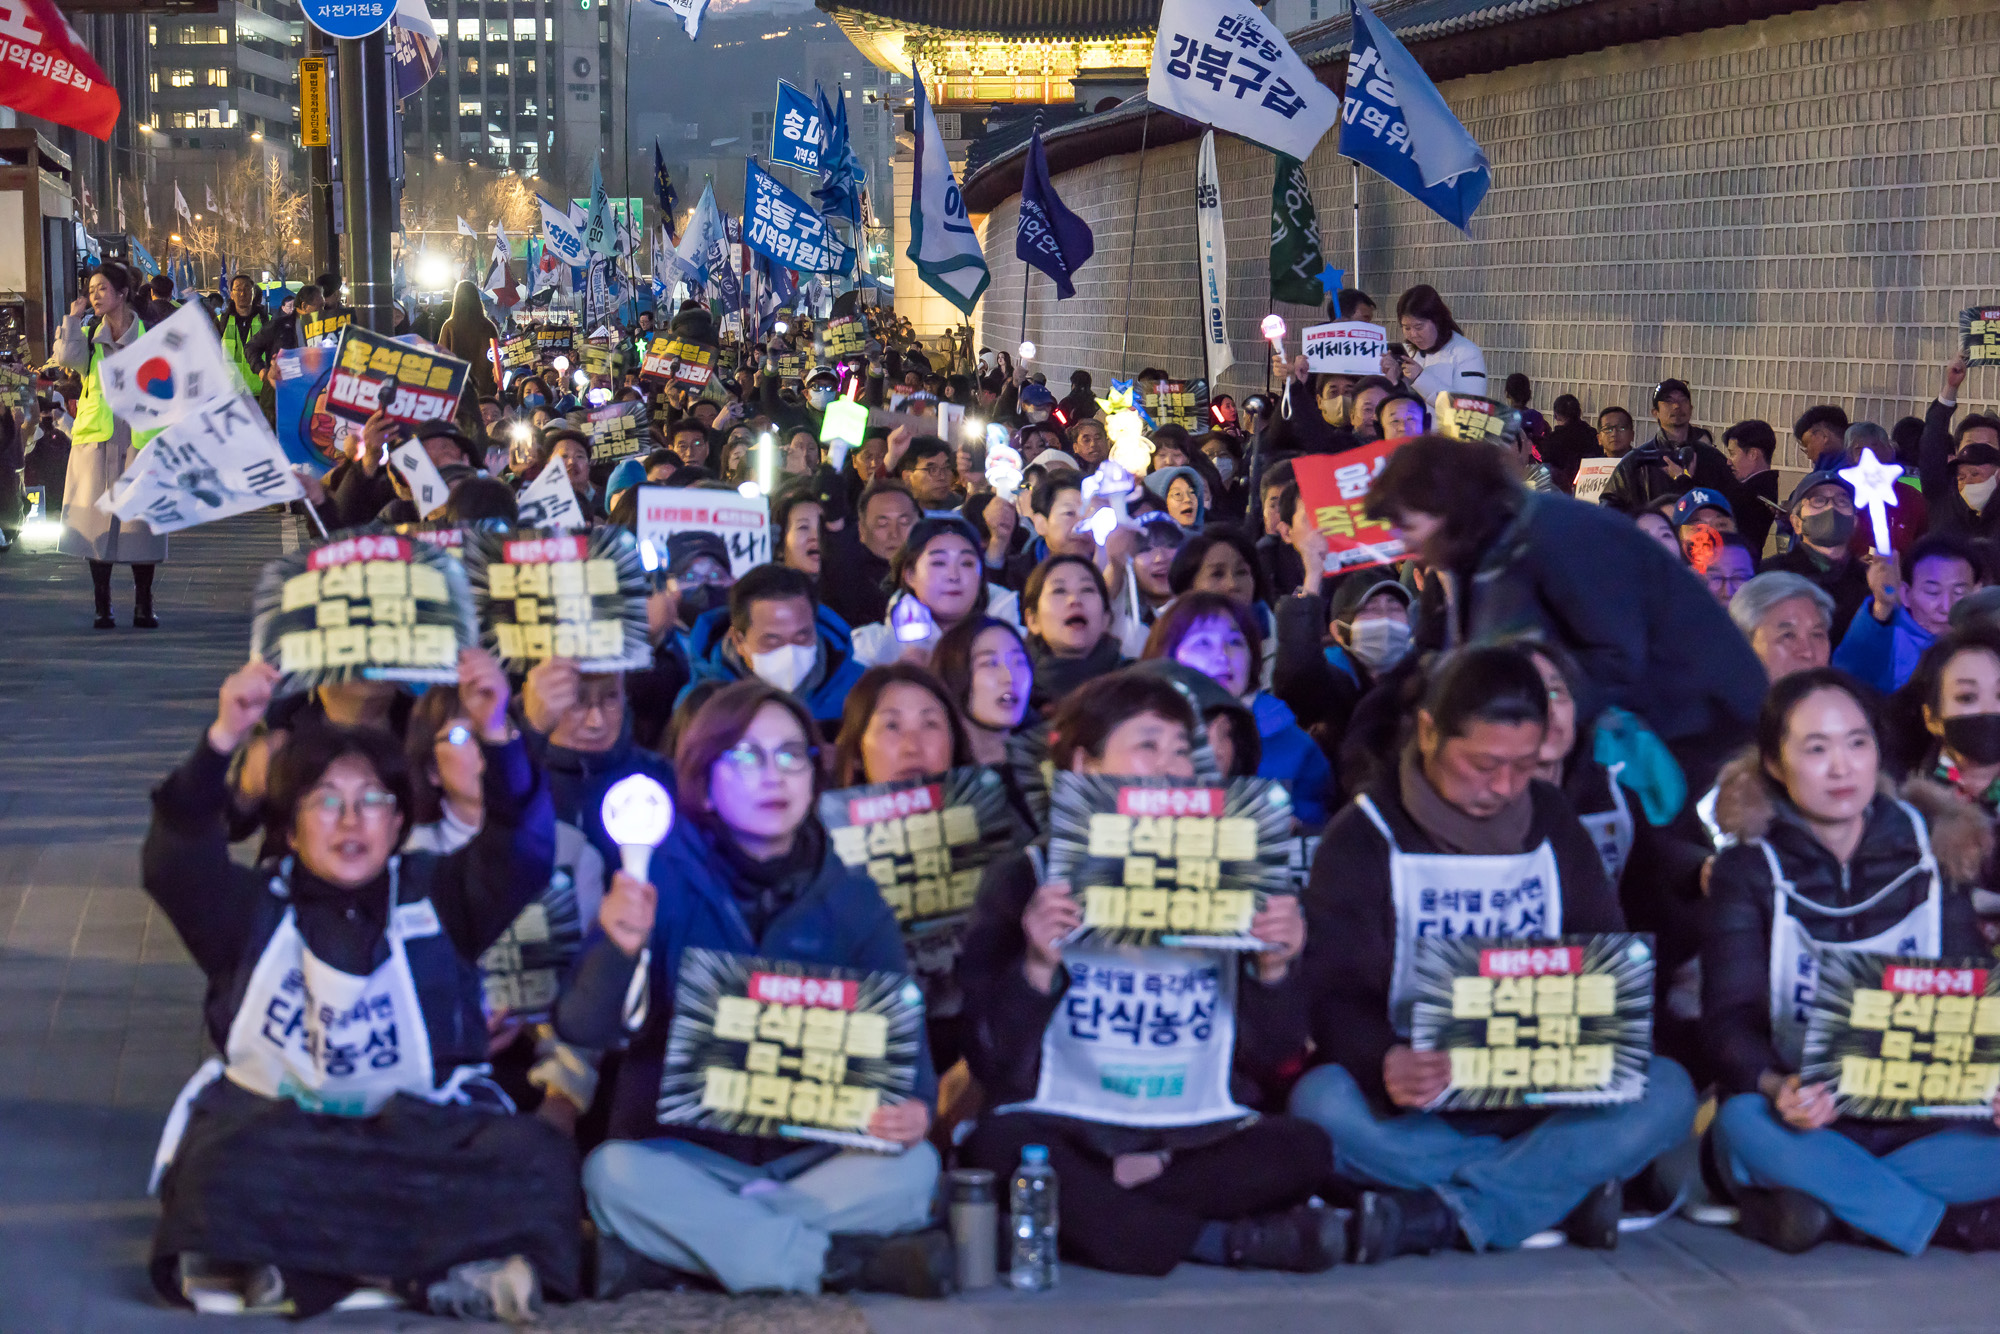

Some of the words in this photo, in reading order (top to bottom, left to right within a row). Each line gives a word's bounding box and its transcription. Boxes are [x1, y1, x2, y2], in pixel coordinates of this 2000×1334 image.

[318, 3, 384, 17] 자전거전용
[1214, 15, 1282, 62] 민주당
[1166, 33, 1307, 119] 강북구갑
[748, 216, 842, 271] 지역위원회
[341, 339, 453, 391] 윤석열을
[1306, 341, 1384, 359] 해체하라!
[332, 374, 455, 422] 파면하라!
[1692, 490, 1709, 504] LA
[1067, 995, 1218, 1047] 단식농성
